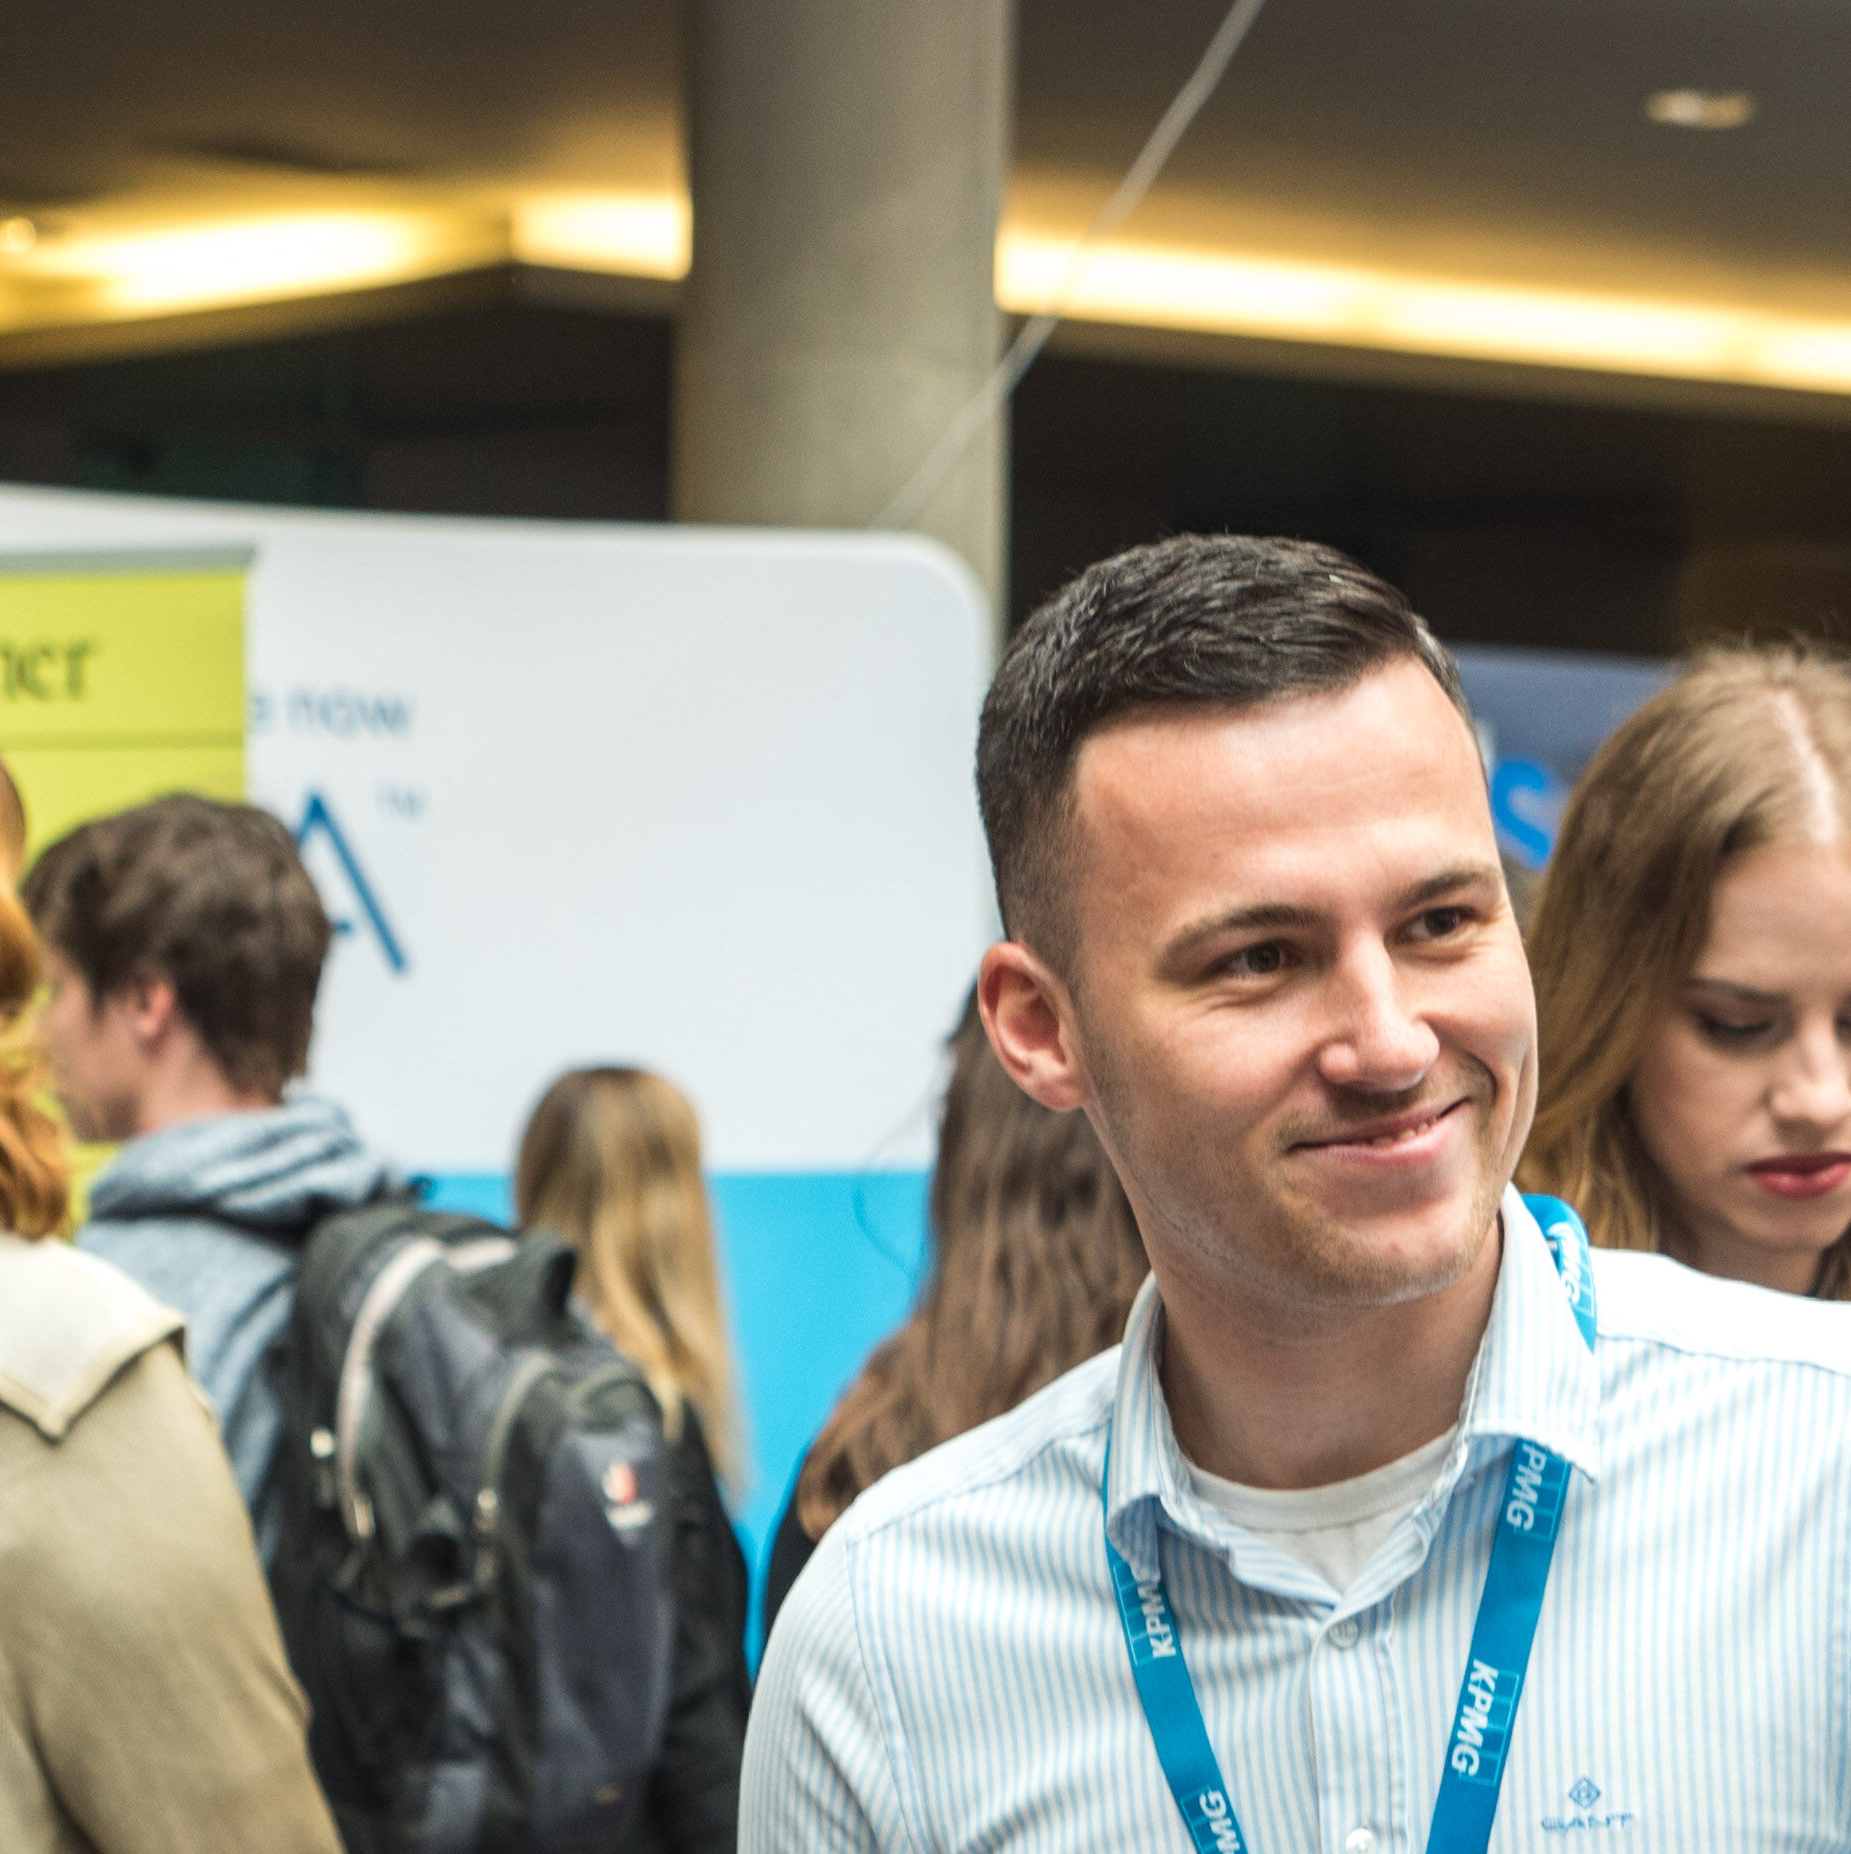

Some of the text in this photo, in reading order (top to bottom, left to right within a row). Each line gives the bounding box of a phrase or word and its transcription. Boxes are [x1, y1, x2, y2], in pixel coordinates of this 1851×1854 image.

[1506, 1442, 1547, 1532] PMG
[1136, 1581, 1177, 1659] KPM
[1451, 1657, 1499, 1777] KPMG
